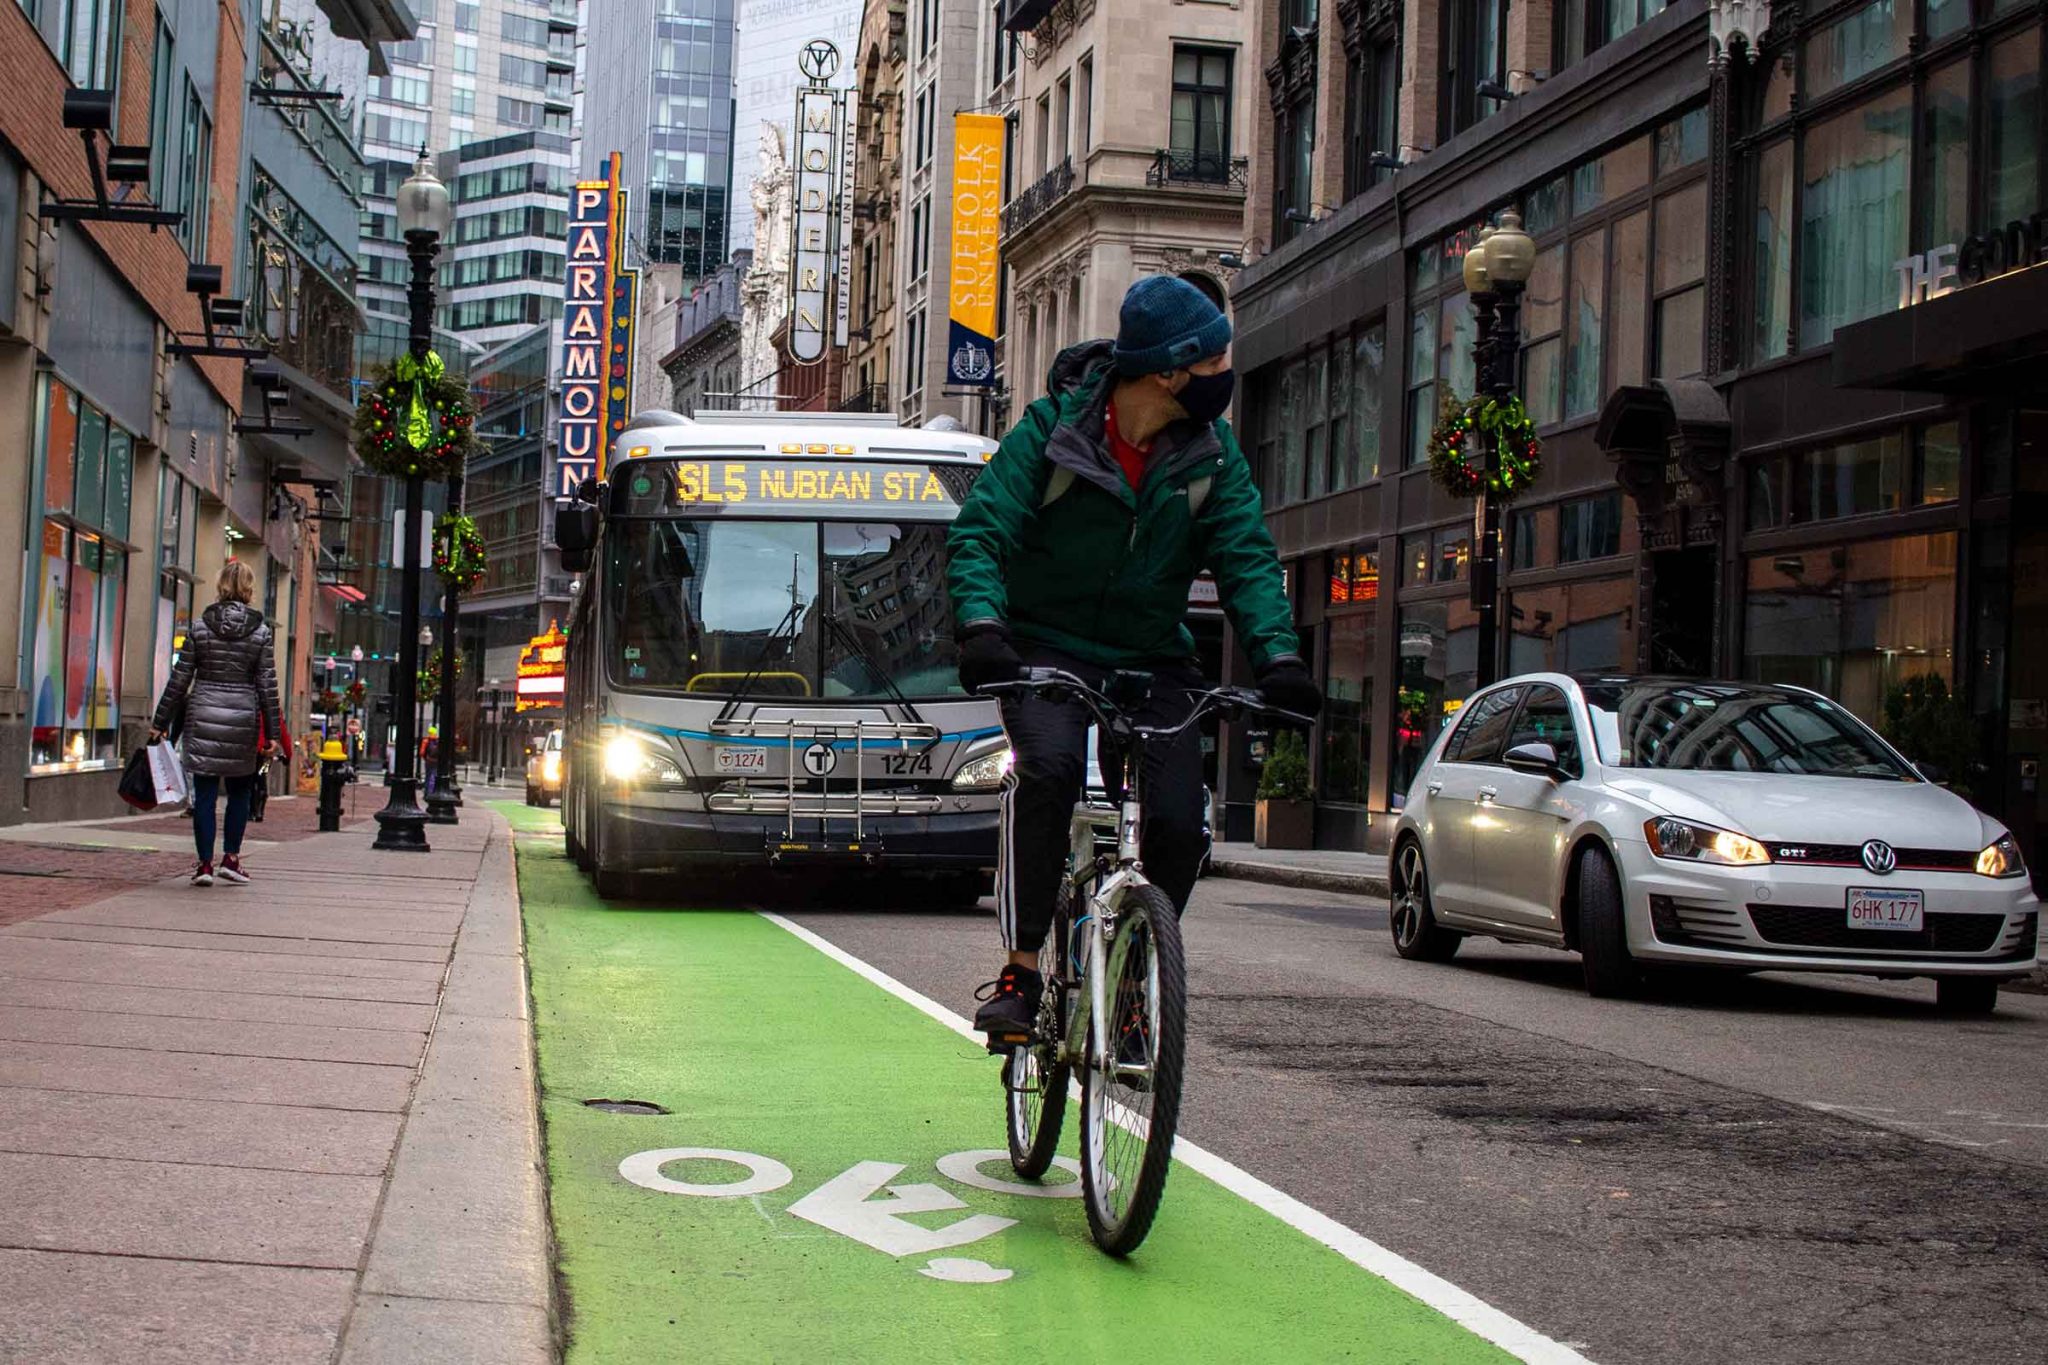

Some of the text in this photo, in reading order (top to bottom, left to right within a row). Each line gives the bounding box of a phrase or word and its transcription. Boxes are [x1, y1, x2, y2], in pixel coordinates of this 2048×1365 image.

[799, 109, 829, 332] MODERN
[838, 120, 855, 322] SUFFOLK UNIVERSITY
[955, 143, 982, 308] SUFFOLK
[978, 143, 999, 308] UNIVERSITY
[1892, 243, 1957, 310] THE
[562, 189, 602, 497] PARAMOUN
[677, 463, 944, 502] SL5 NUBIAN STA
[734, 753, 764, 768] 1274
[880, 754, 933, 775] 1274
[1779, 848, 1806, 858] GTI
[1852, 900, 1919, 921] 6HK 177
